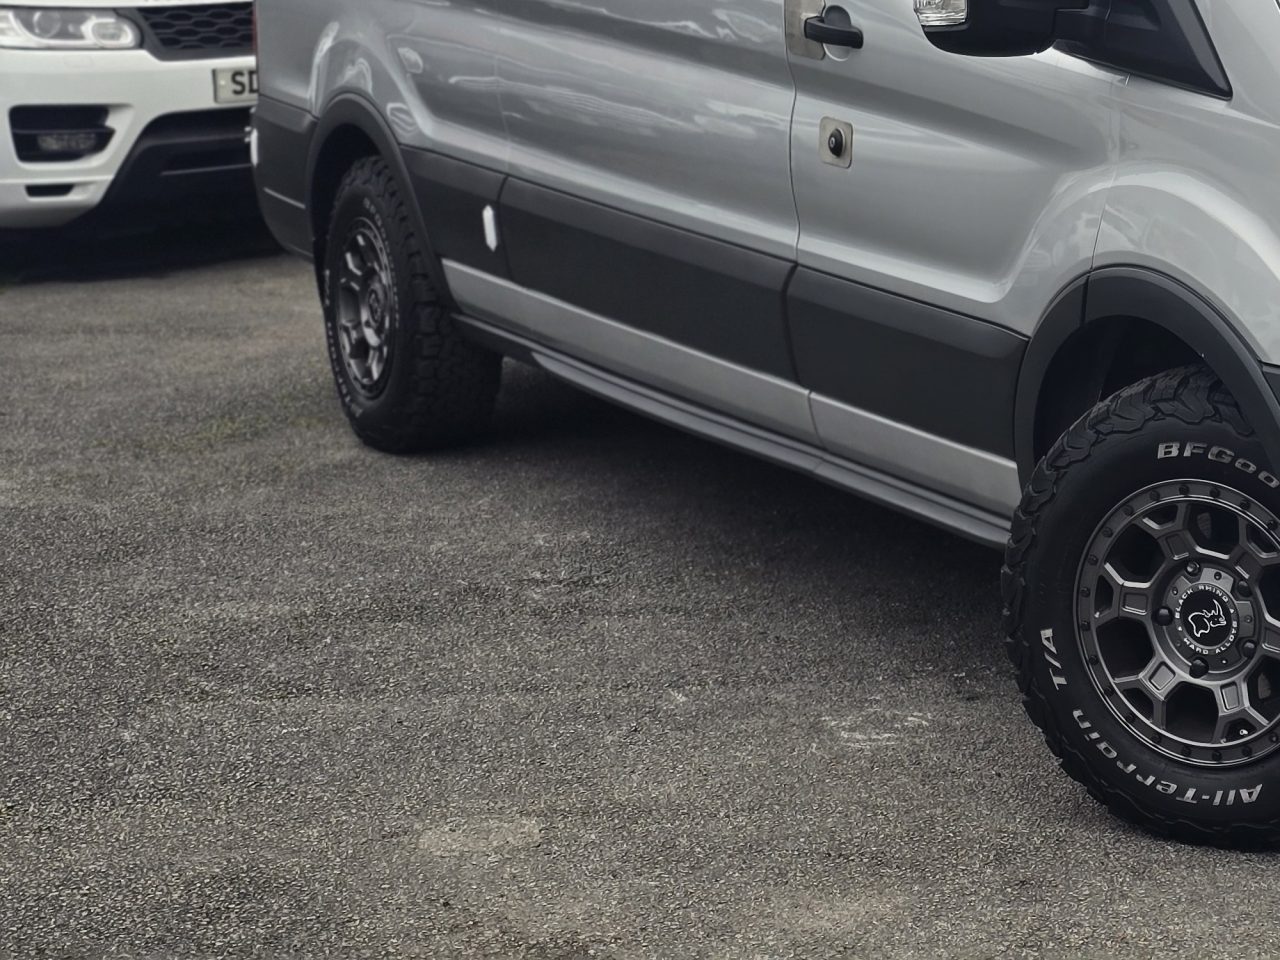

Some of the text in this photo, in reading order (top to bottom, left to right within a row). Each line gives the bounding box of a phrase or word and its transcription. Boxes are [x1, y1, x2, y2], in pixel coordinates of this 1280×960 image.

[1175, 584, 1228, 619] BLACK RHINO
[1184, 621, 1238, 655] HARD ALLOYS
[1040, 628, 1263, 806] All-Terrain T/A
